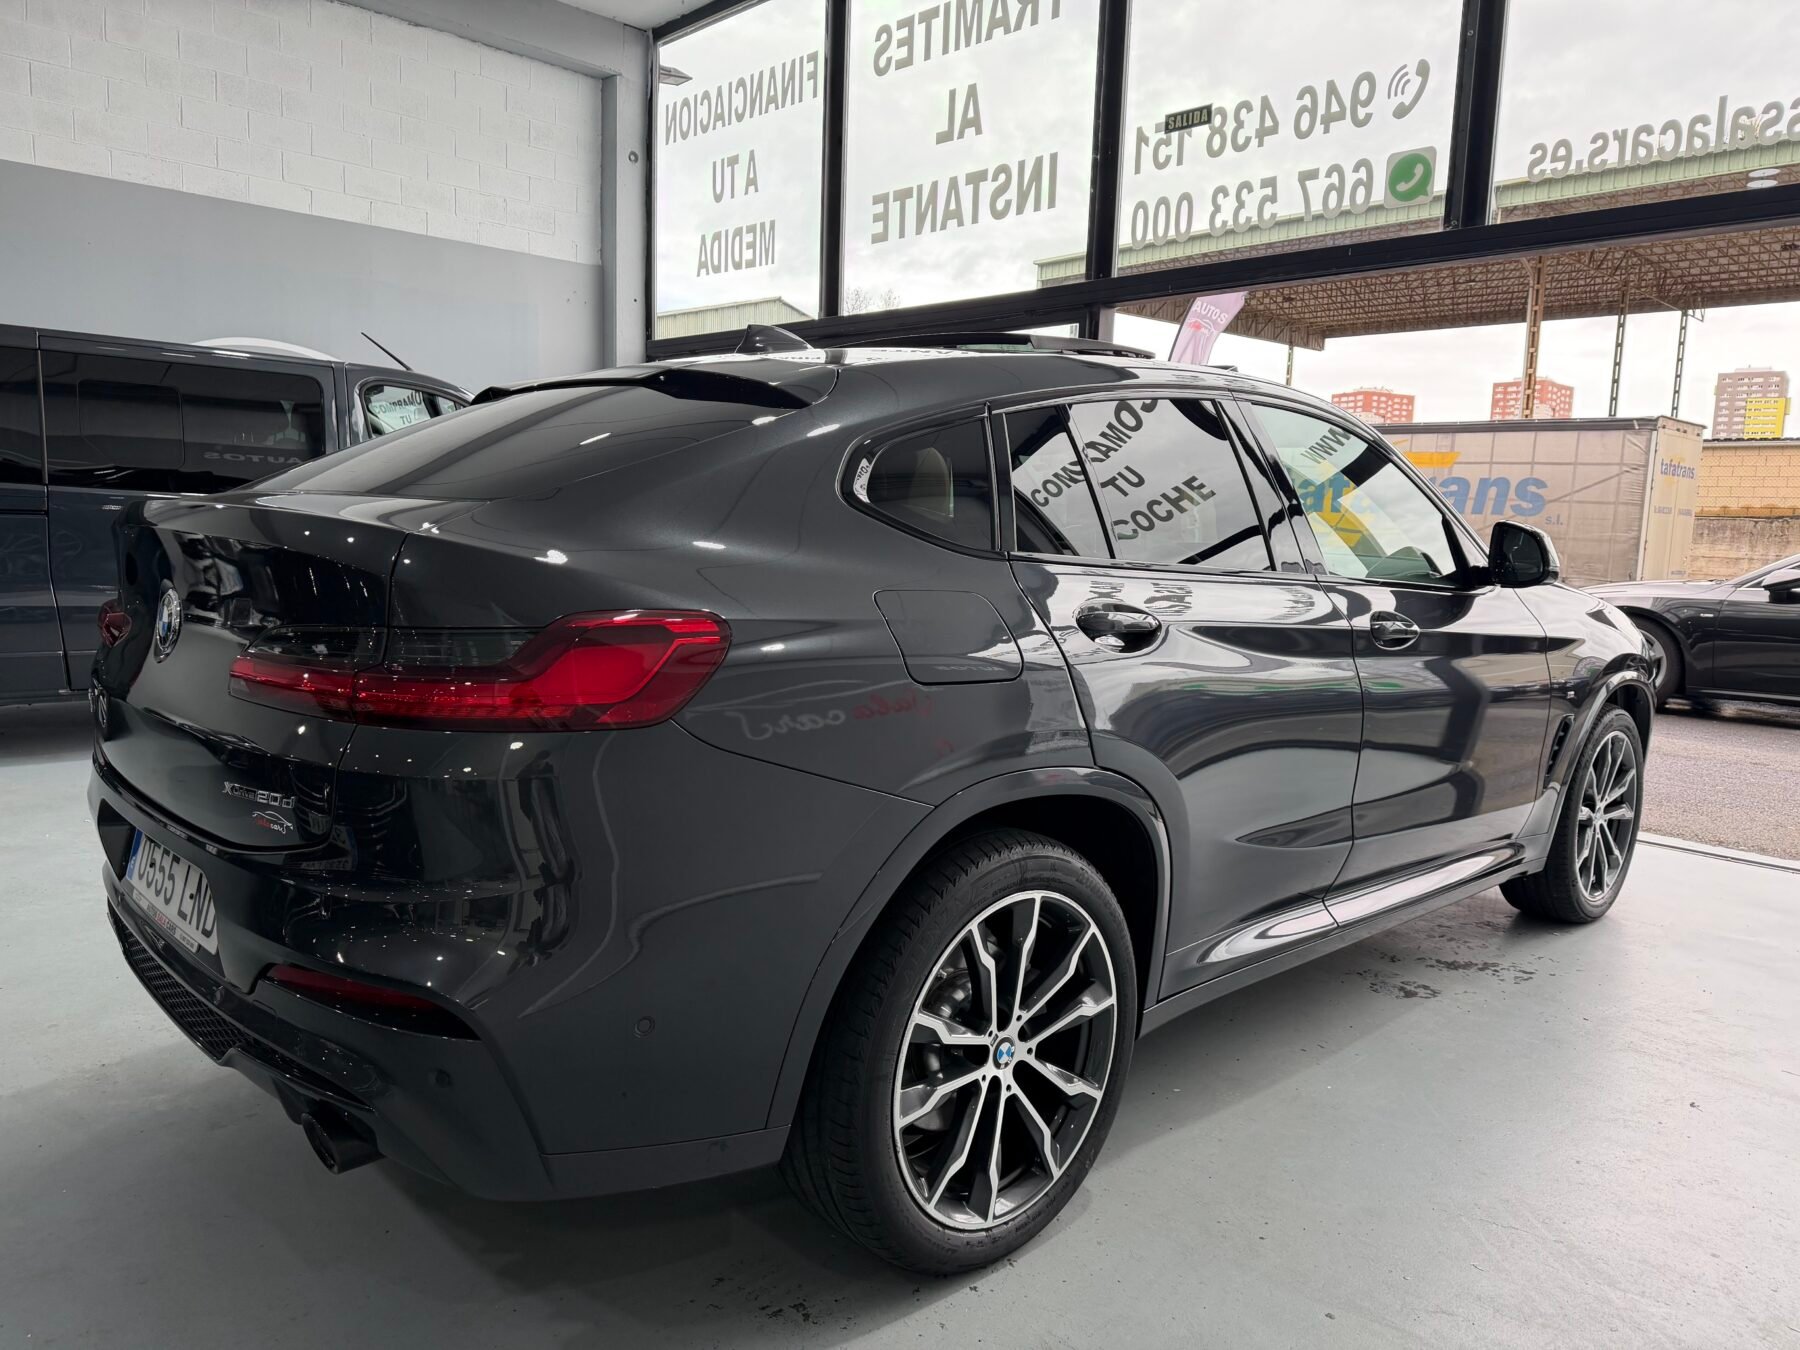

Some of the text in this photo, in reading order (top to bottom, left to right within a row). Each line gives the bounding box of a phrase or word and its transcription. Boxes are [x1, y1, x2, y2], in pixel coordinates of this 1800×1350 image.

[1167, 107, 1209, 131] SALIDA
[1193, 301, 1228, 324] AUTOS
[371, 390, 423, 416] COMPRAMO
[1031, 400, 1159, 508] COMAMO
[1100, 465, 1145, 498] TU
[1660, 458, 1696, 480] tafatrans
[1112, 475, 1216, 541] COCHE
[137, 836, 181, 906] 0555
